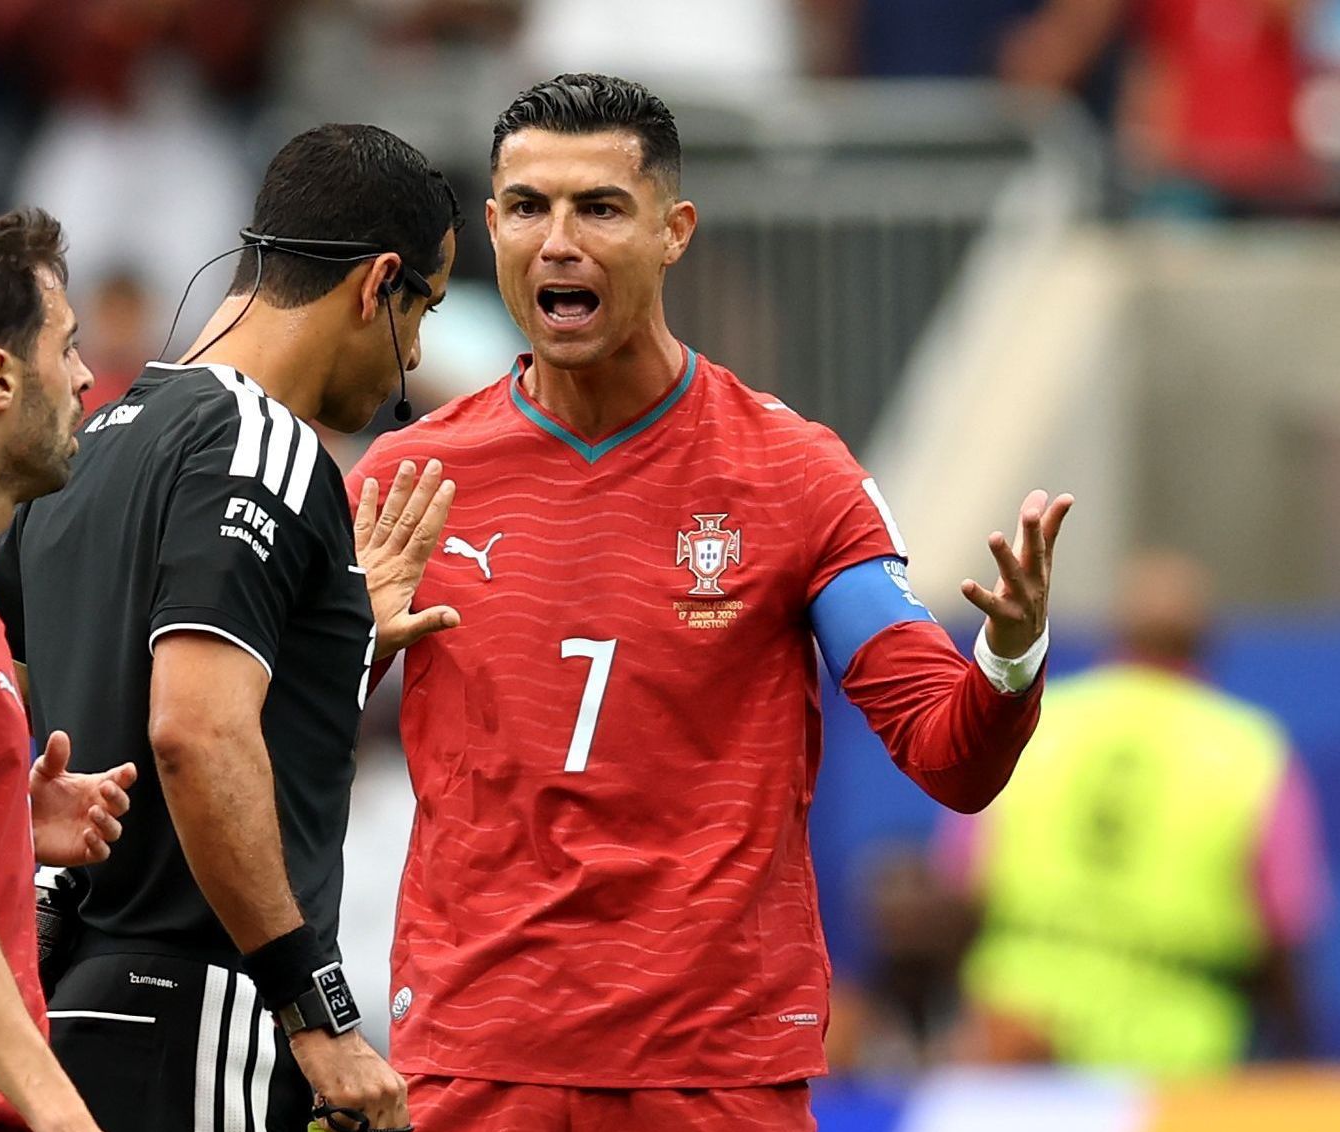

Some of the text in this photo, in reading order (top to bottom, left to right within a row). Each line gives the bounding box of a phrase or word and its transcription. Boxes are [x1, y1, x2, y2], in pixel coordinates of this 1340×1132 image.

[220, 525, 270, 562] TEAM ONE
[224, 496, 276, 546] FIFA
[688, 619, 729, 629] HOUSTON
[561, 637, 618, 773] 7
[321, 970, 350, 1019] 21:21
